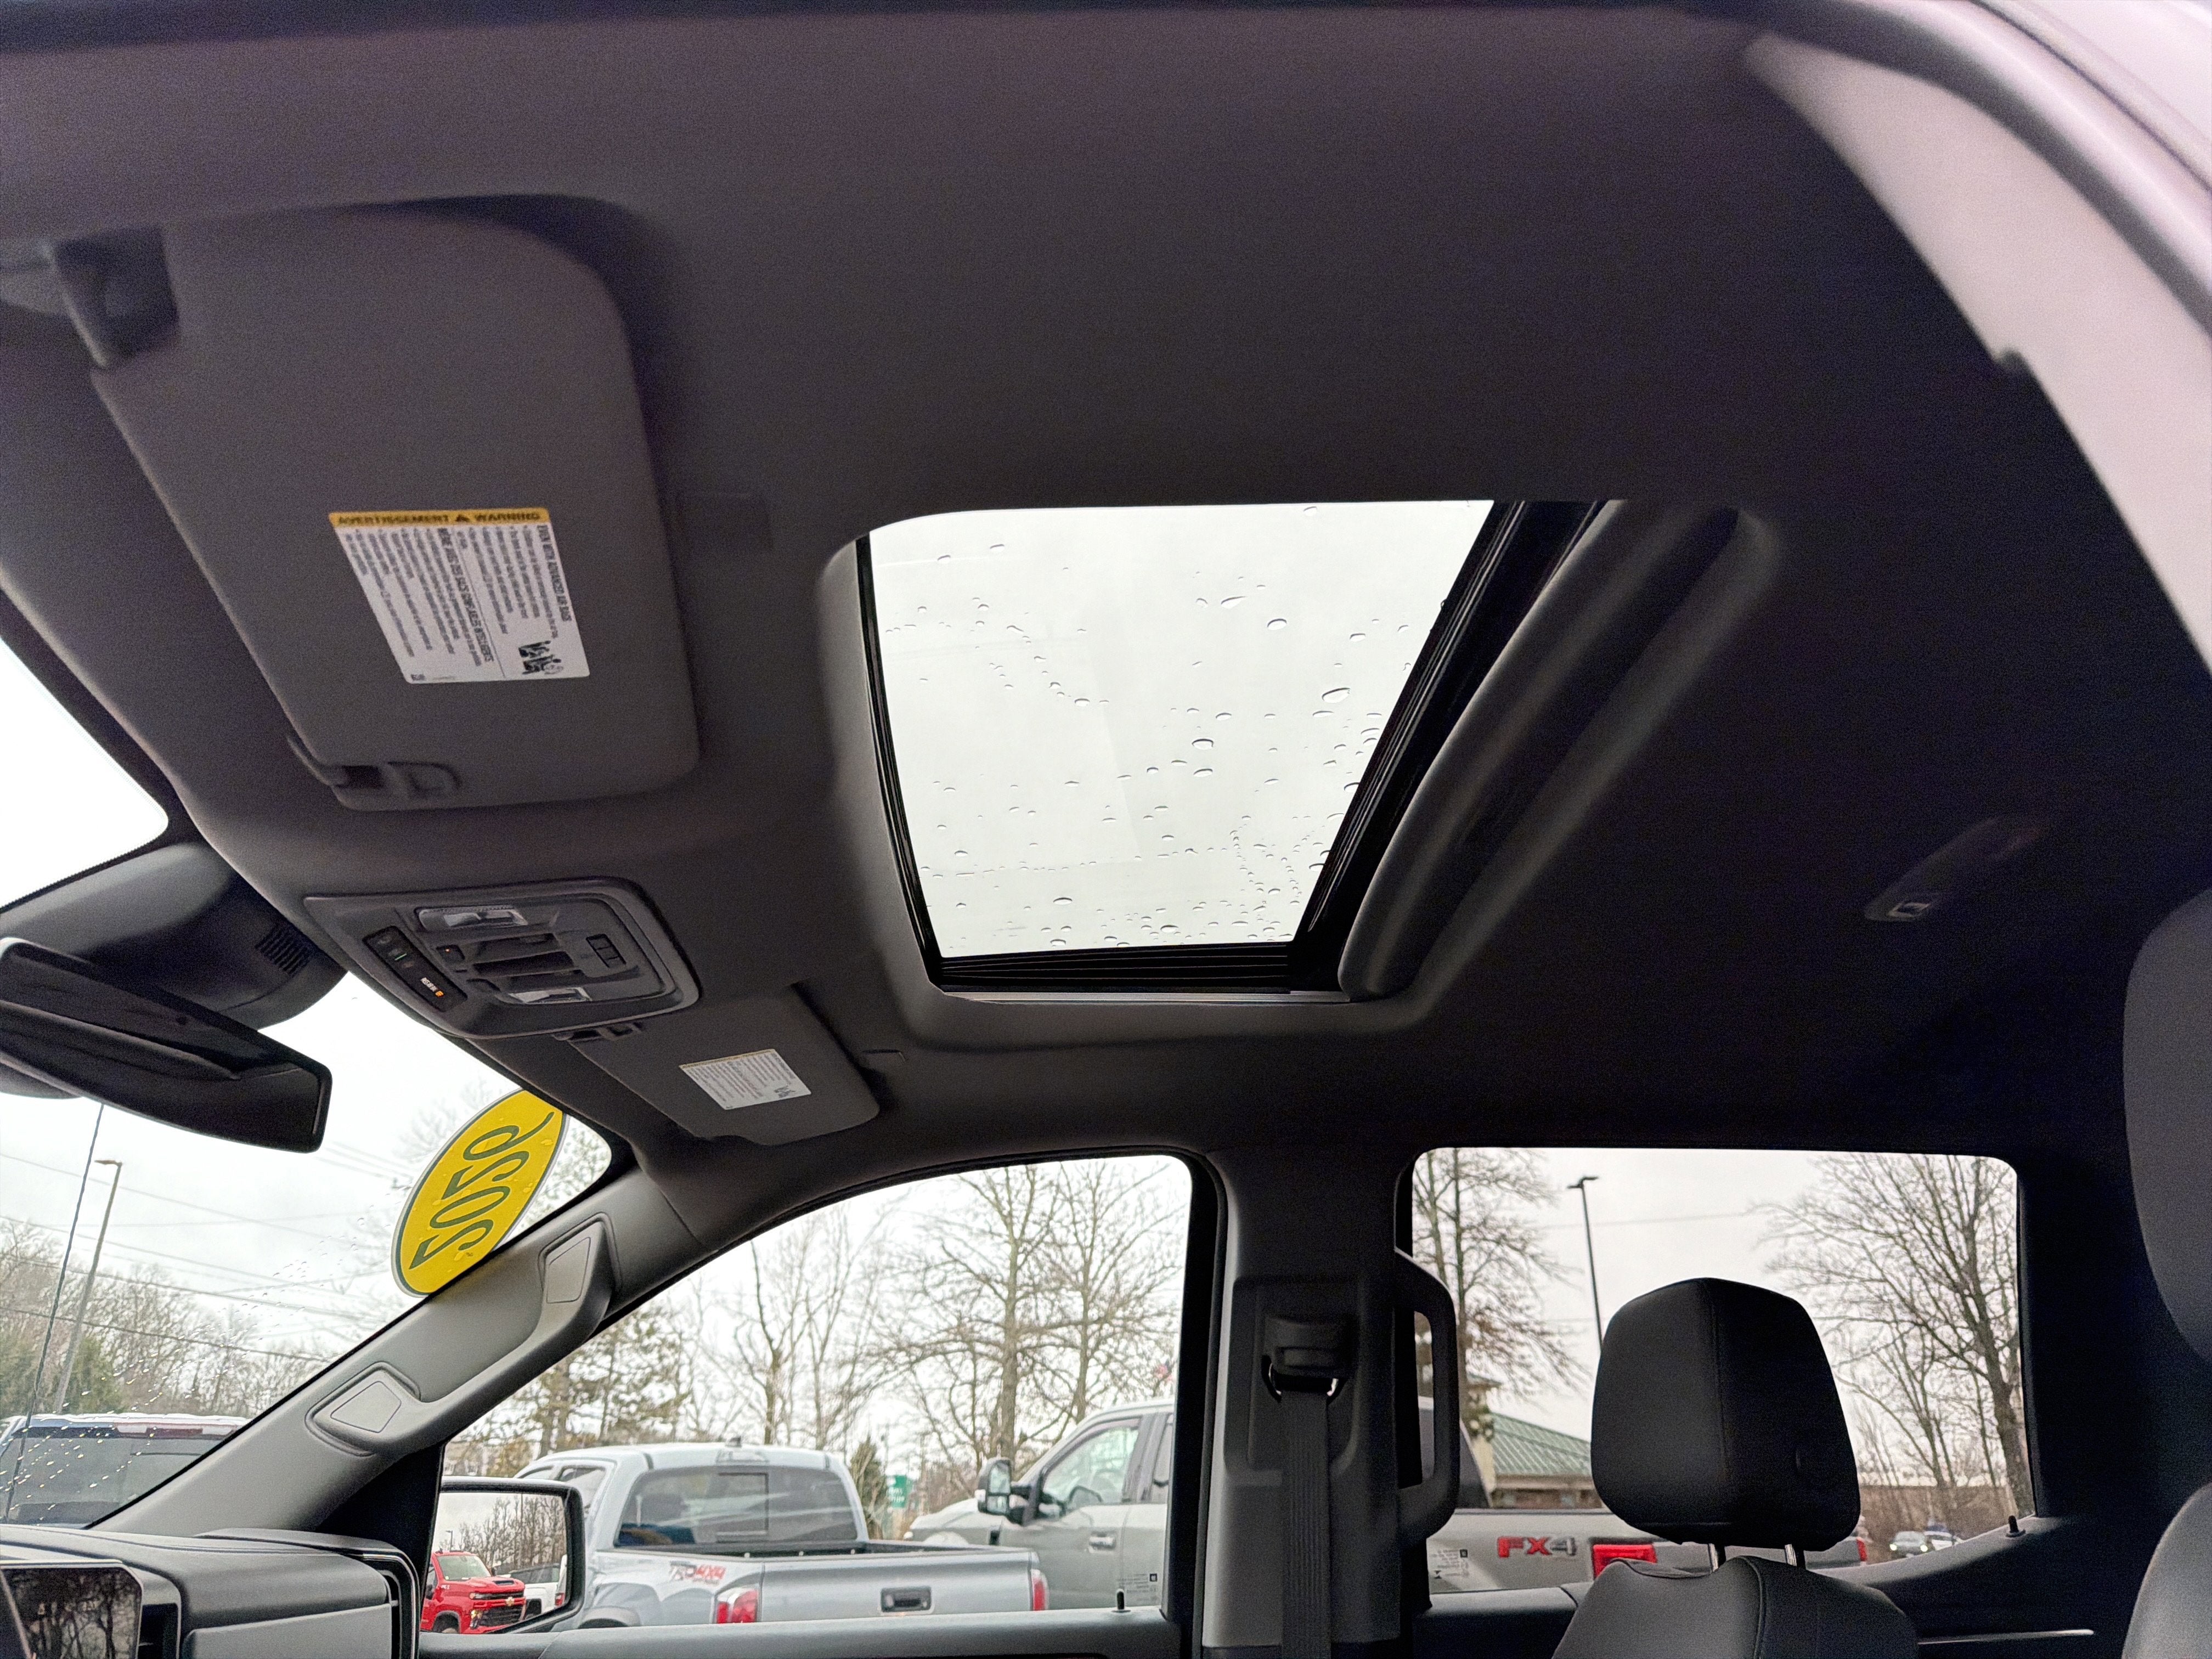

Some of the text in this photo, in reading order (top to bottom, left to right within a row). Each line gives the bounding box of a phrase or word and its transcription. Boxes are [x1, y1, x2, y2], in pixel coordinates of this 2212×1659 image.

[338, 511, 540, 525] AVERTISSEMENT WARNING
[1498, 1536, 1577, 1558] FX4
